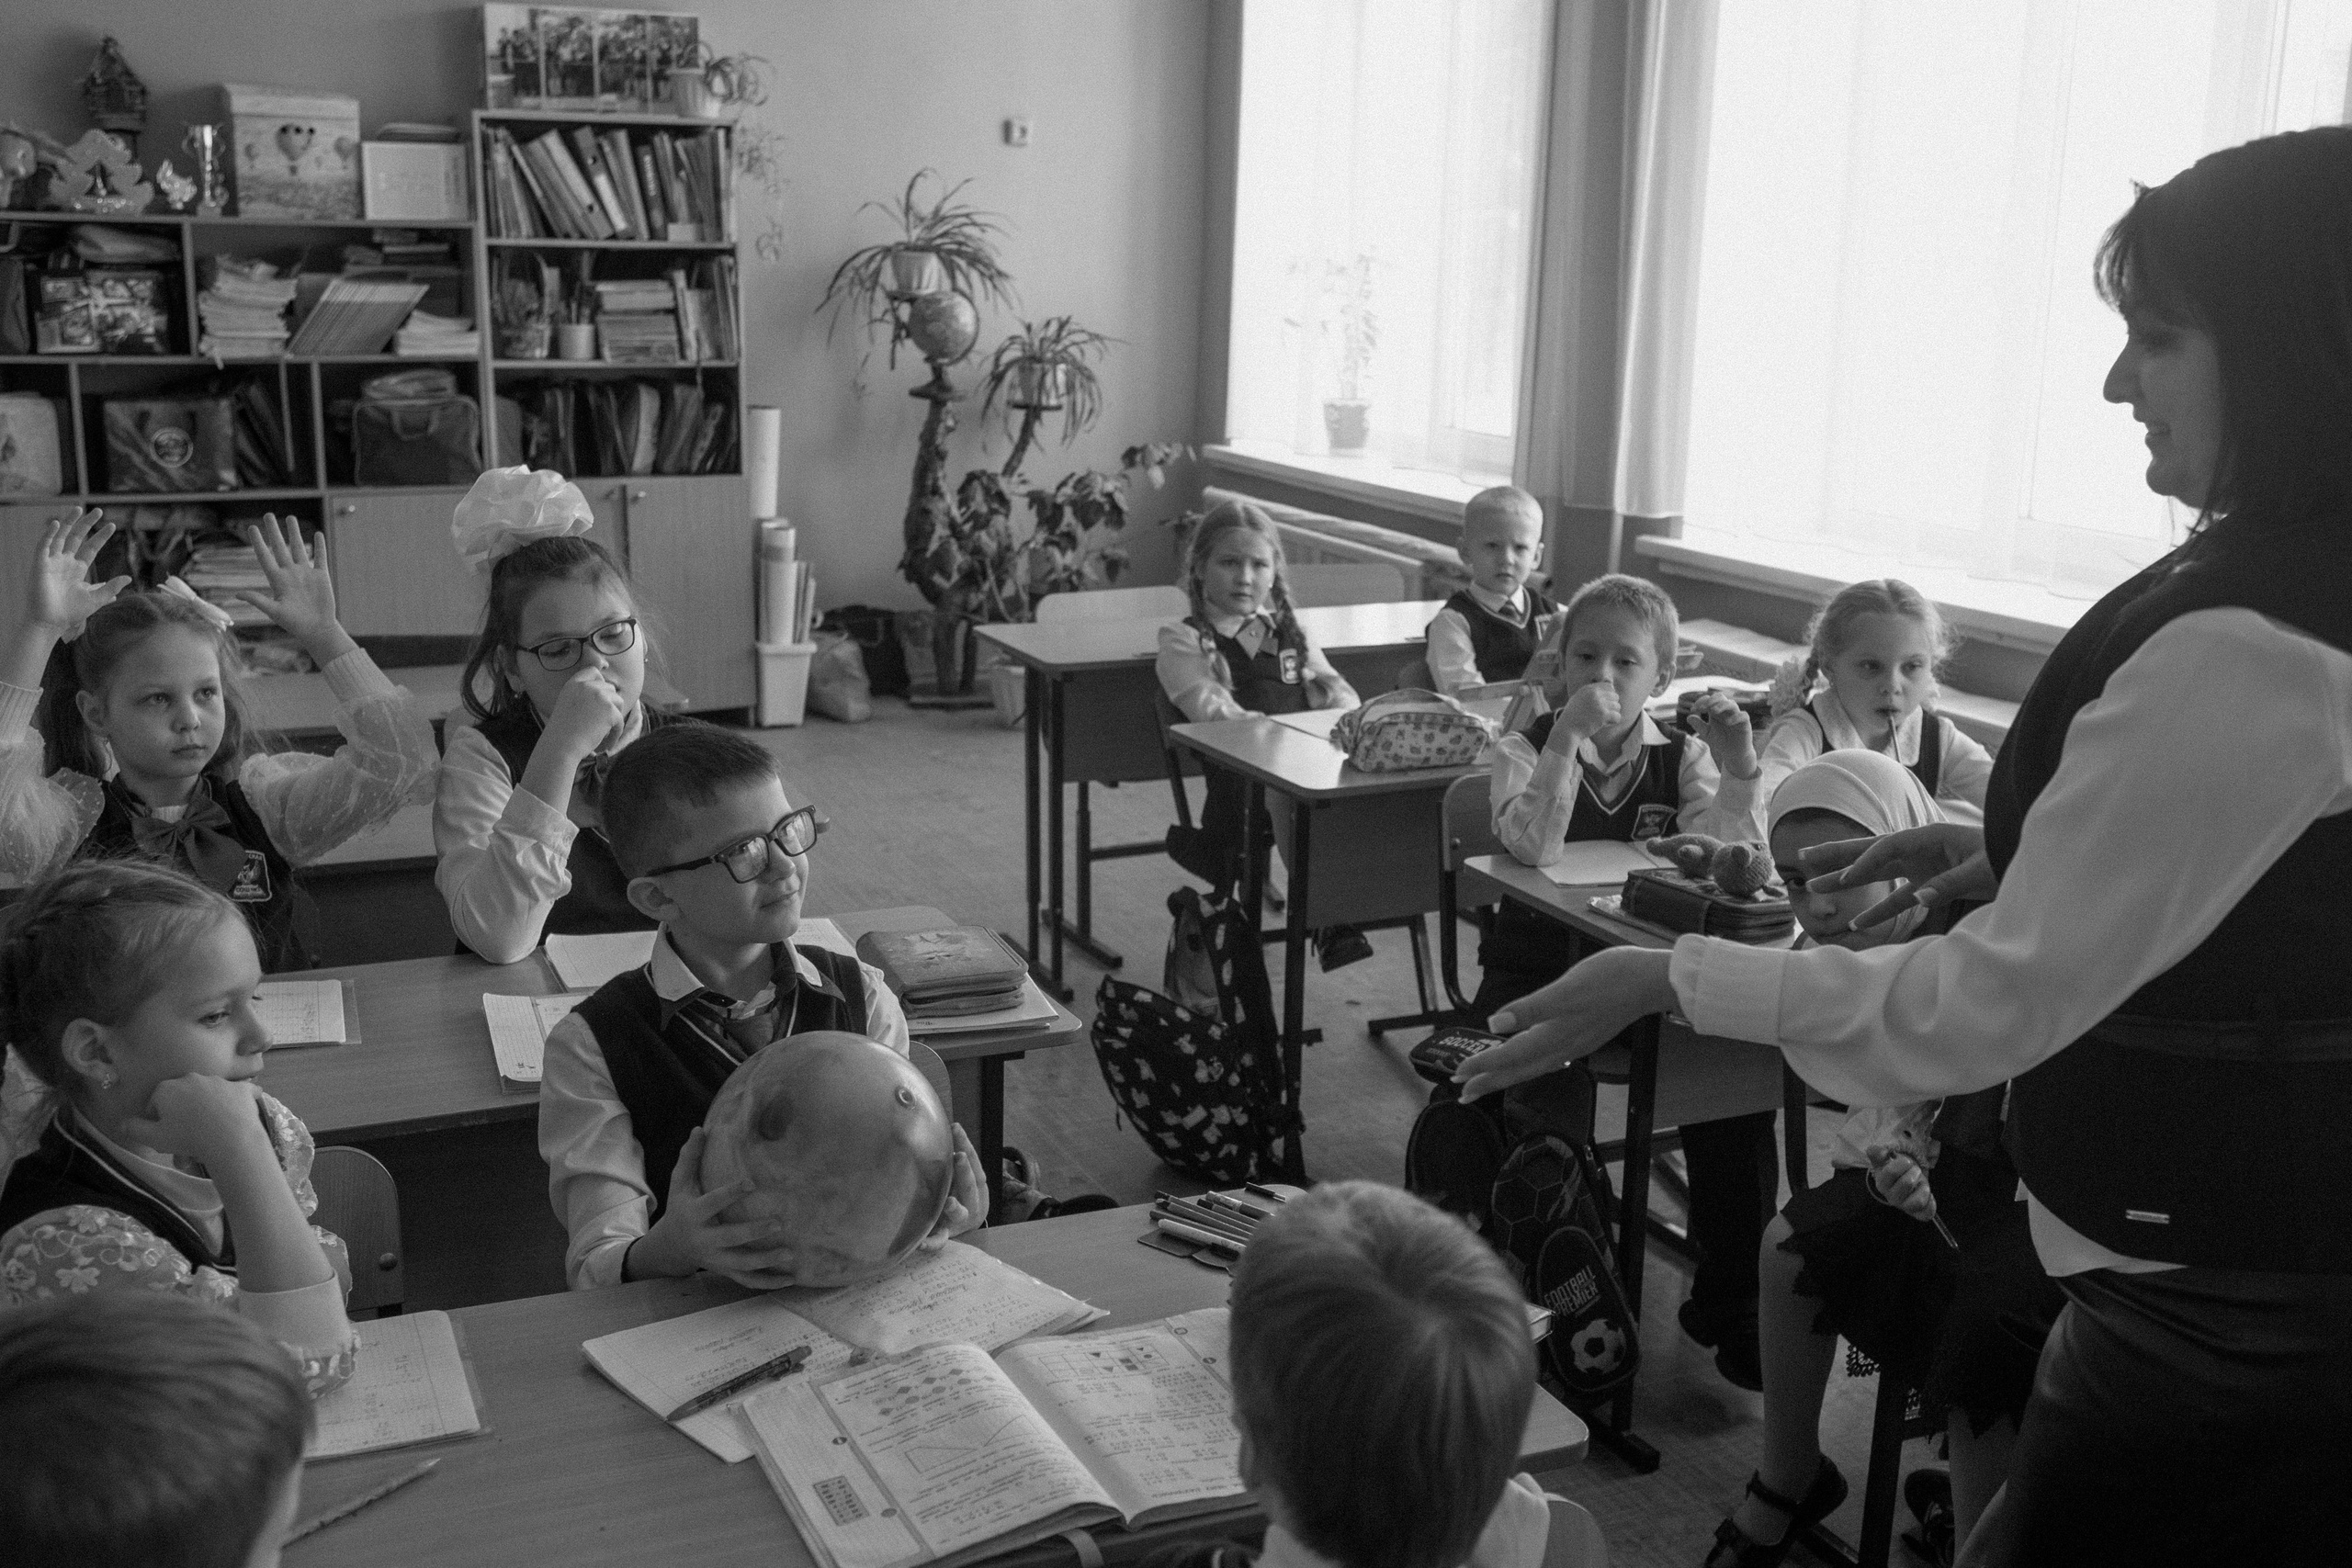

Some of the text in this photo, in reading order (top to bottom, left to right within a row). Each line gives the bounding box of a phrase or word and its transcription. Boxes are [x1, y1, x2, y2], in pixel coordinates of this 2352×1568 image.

[1439, 1036, 1485, 1054] SOCCER
[1544, 1264, 1597, 1307] FOOTBALL
[1554, 1281, 1599, 1320] PREMIER
